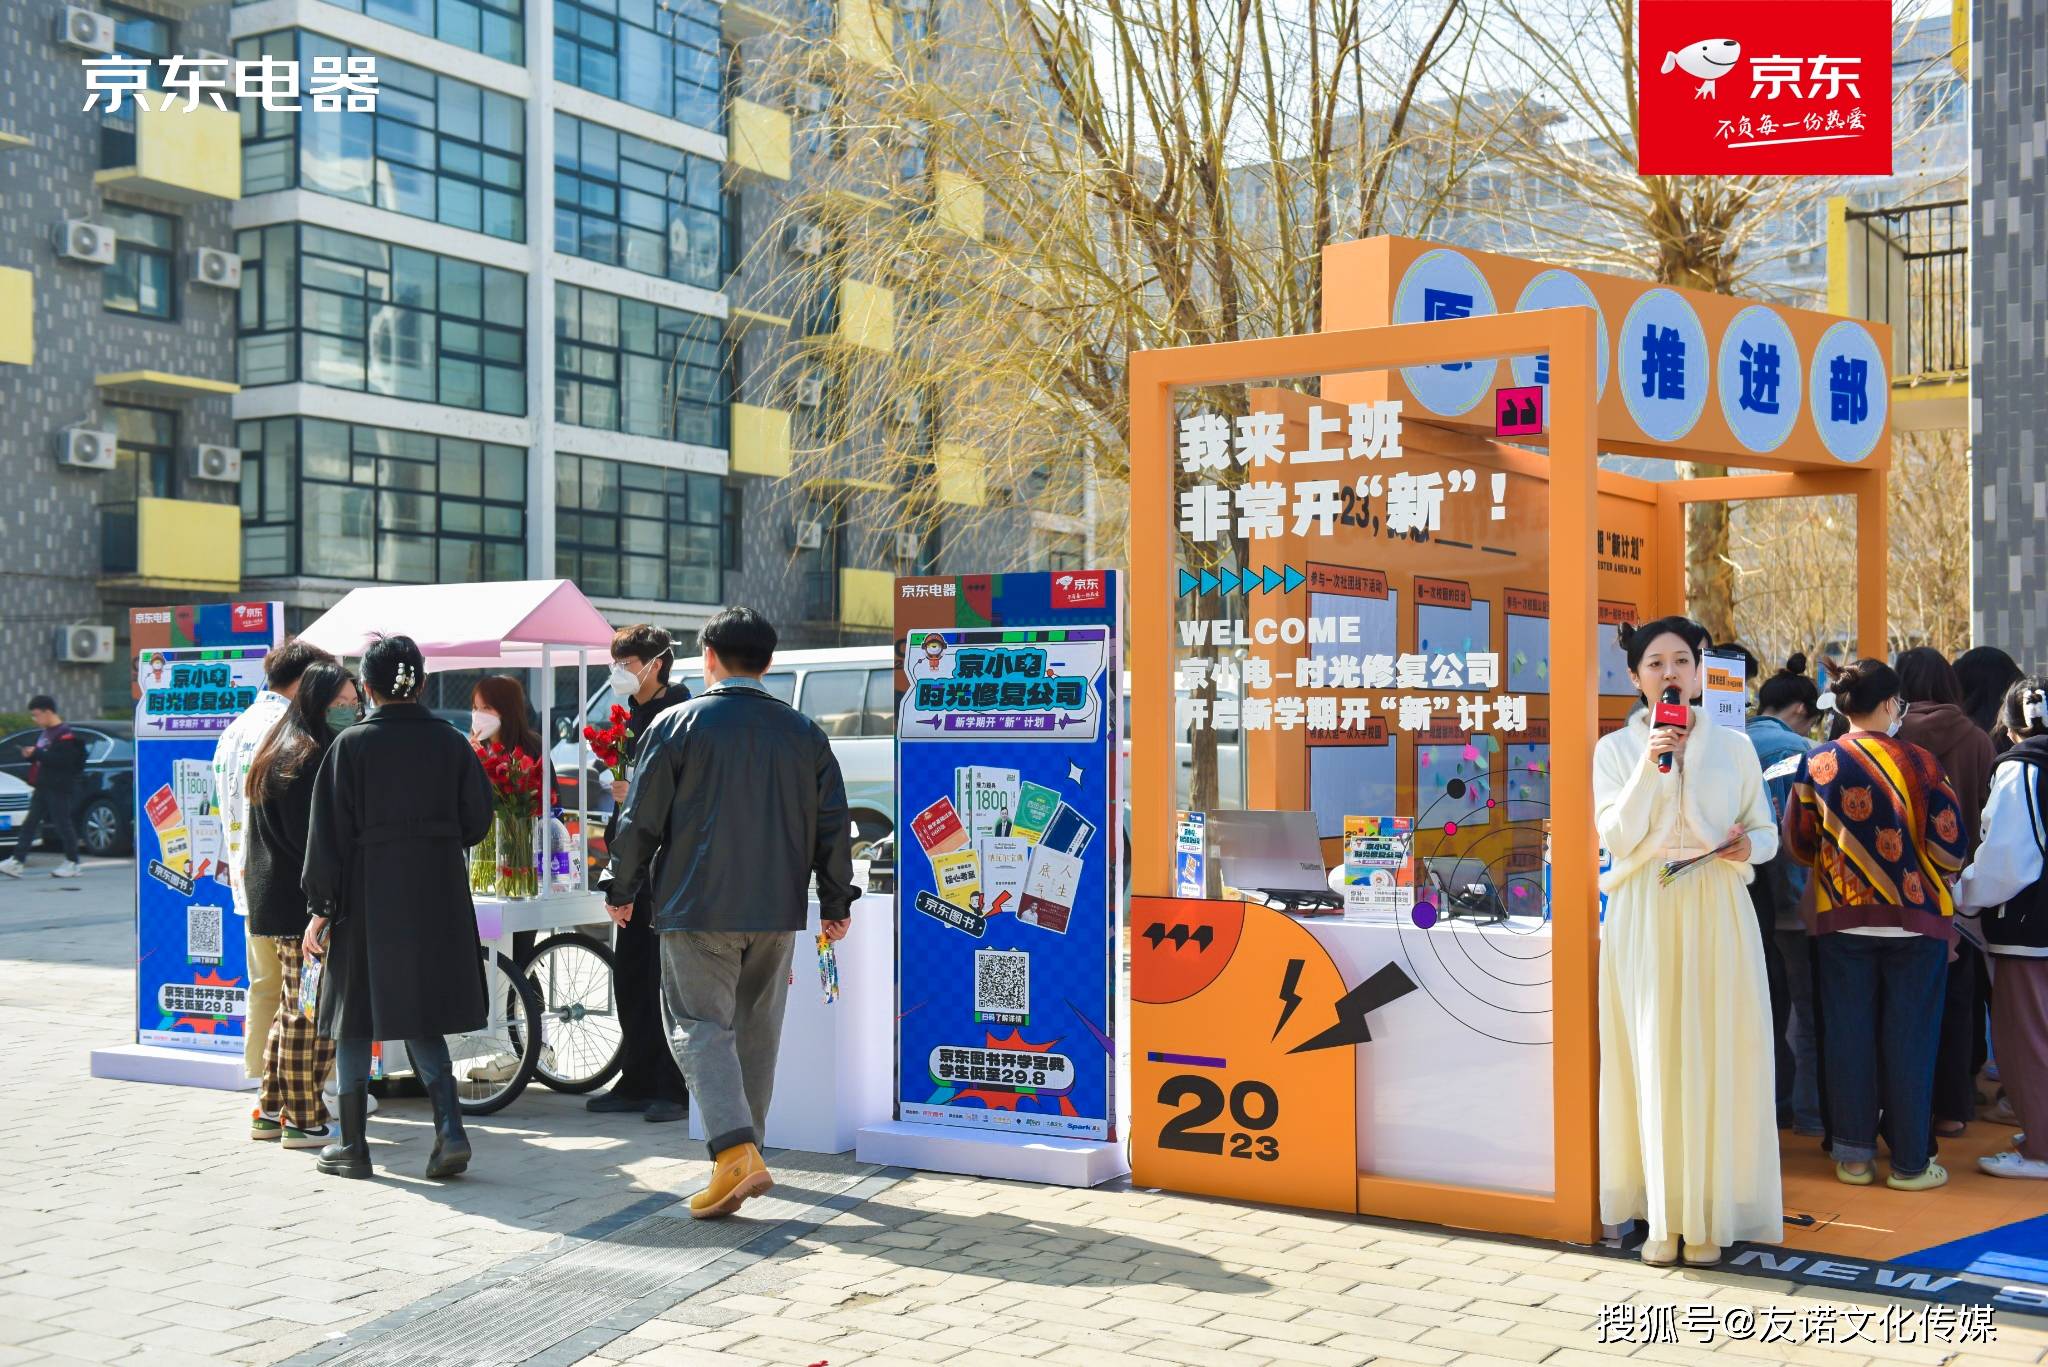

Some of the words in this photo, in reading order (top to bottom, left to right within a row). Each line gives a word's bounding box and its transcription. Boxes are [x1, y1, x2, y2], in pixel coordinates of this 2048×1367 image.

[1179, 400, 1403, 473] 我来上班
[902, 582, 957, 598] 京东电器
[1074, 578, 1099, 591] 京东
[1179, 616, 1361, 646] WELCOME
[957, 653, 1042, 679] 京小电
[919, 681, 1083, 707] 时光修复公司
[975, 789, 1008, 811] 1800
[154, 867, 188, 891] 京东图书
[925, 897, 976, 930] 京东图书
[164, 999, 233, 1014] 学生低至29.8
[939, 1048, 1065, 1072] 京东图书开学宝典
[939, 1064, 1046, 1086] 学生低至29.8
[1067, 1123, 1091, 1131] Spark
[1731, 1250, 1963, 1292] NEW
